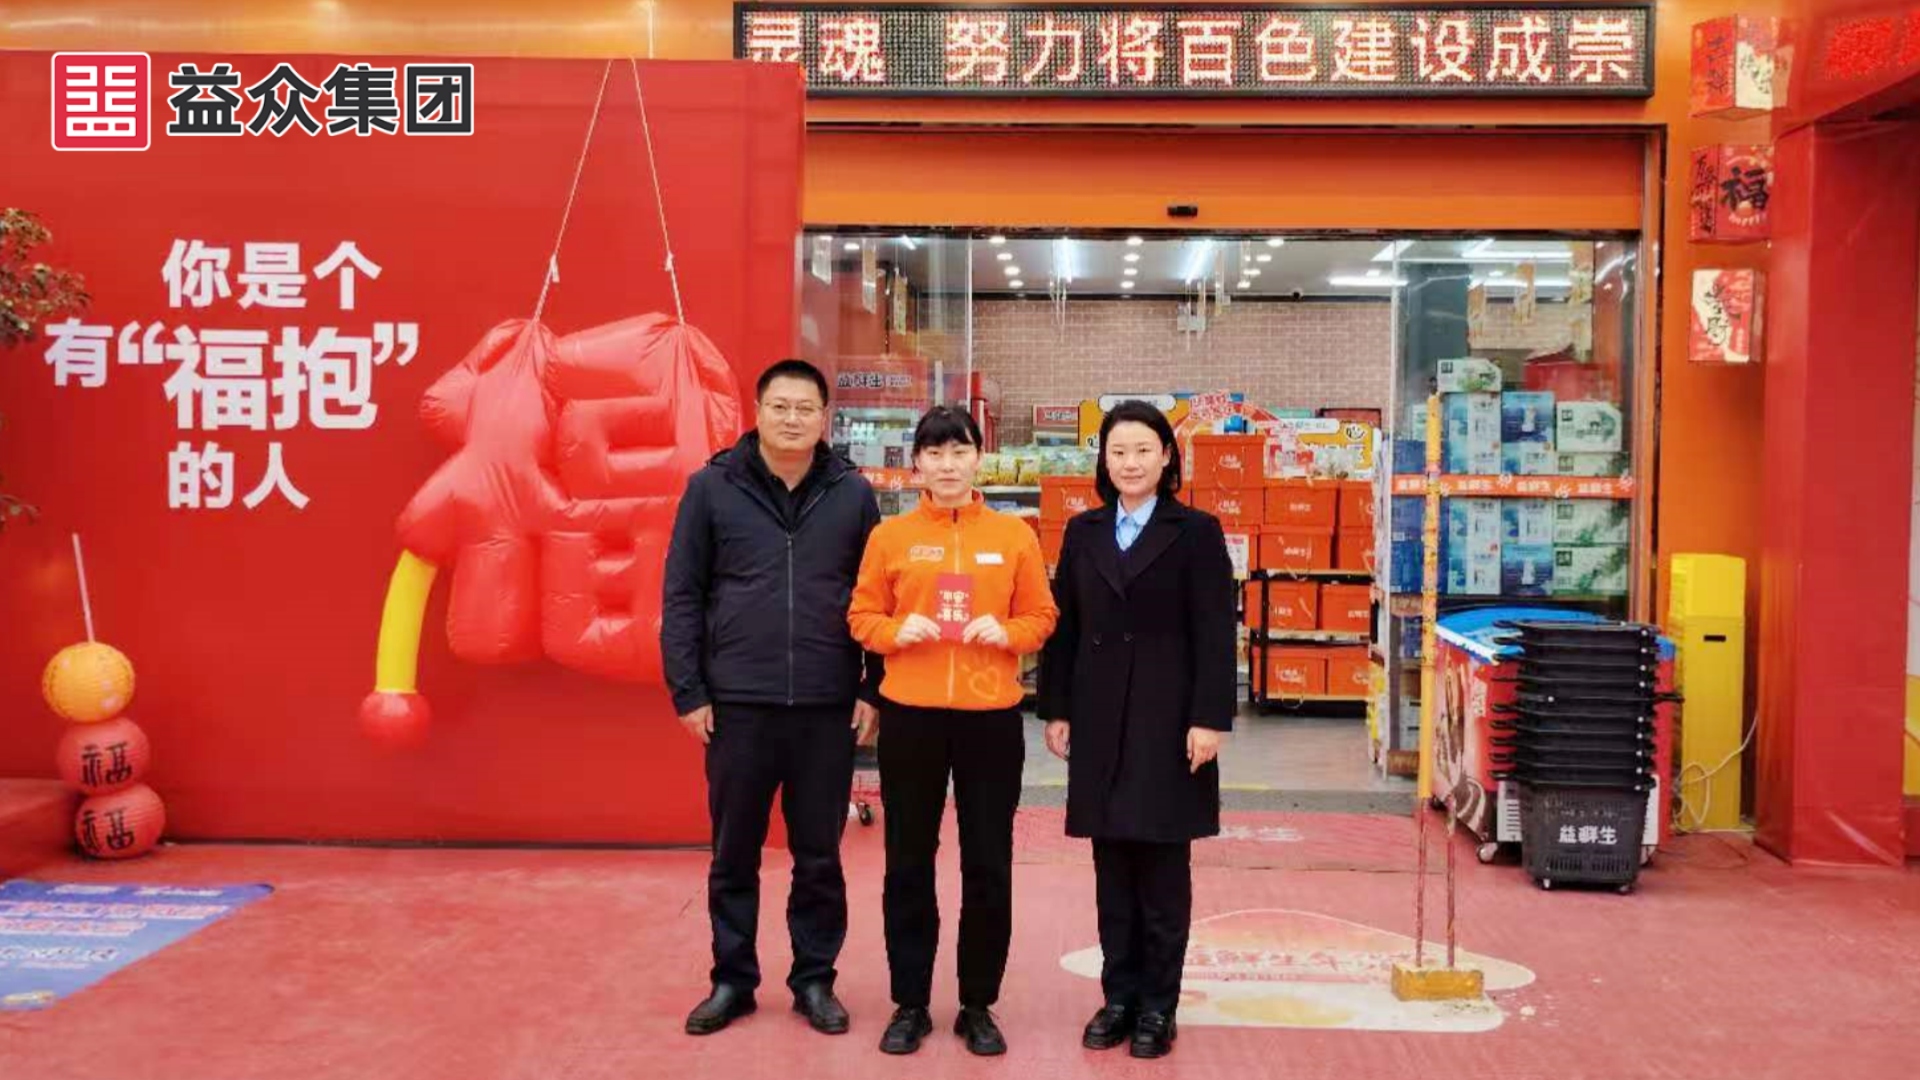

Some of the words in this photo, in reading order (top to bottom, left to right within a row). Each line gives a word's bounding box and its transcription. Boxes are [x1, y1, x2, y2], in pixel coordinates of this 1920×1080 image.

[748, 17, 886, 82] 灵魂
[944, 15, 1634, 84] 努力将百色建设成崇
[162, 239, 381, 309] 你是个
[45, 318, 419, 430] 有“福抱”
[168, 442, 310, 509] 的人
[82, 743, 132, 787] 福
[82, 806, 135, 850] 福
[1558, 824, 1618, 845] 益鲜生
